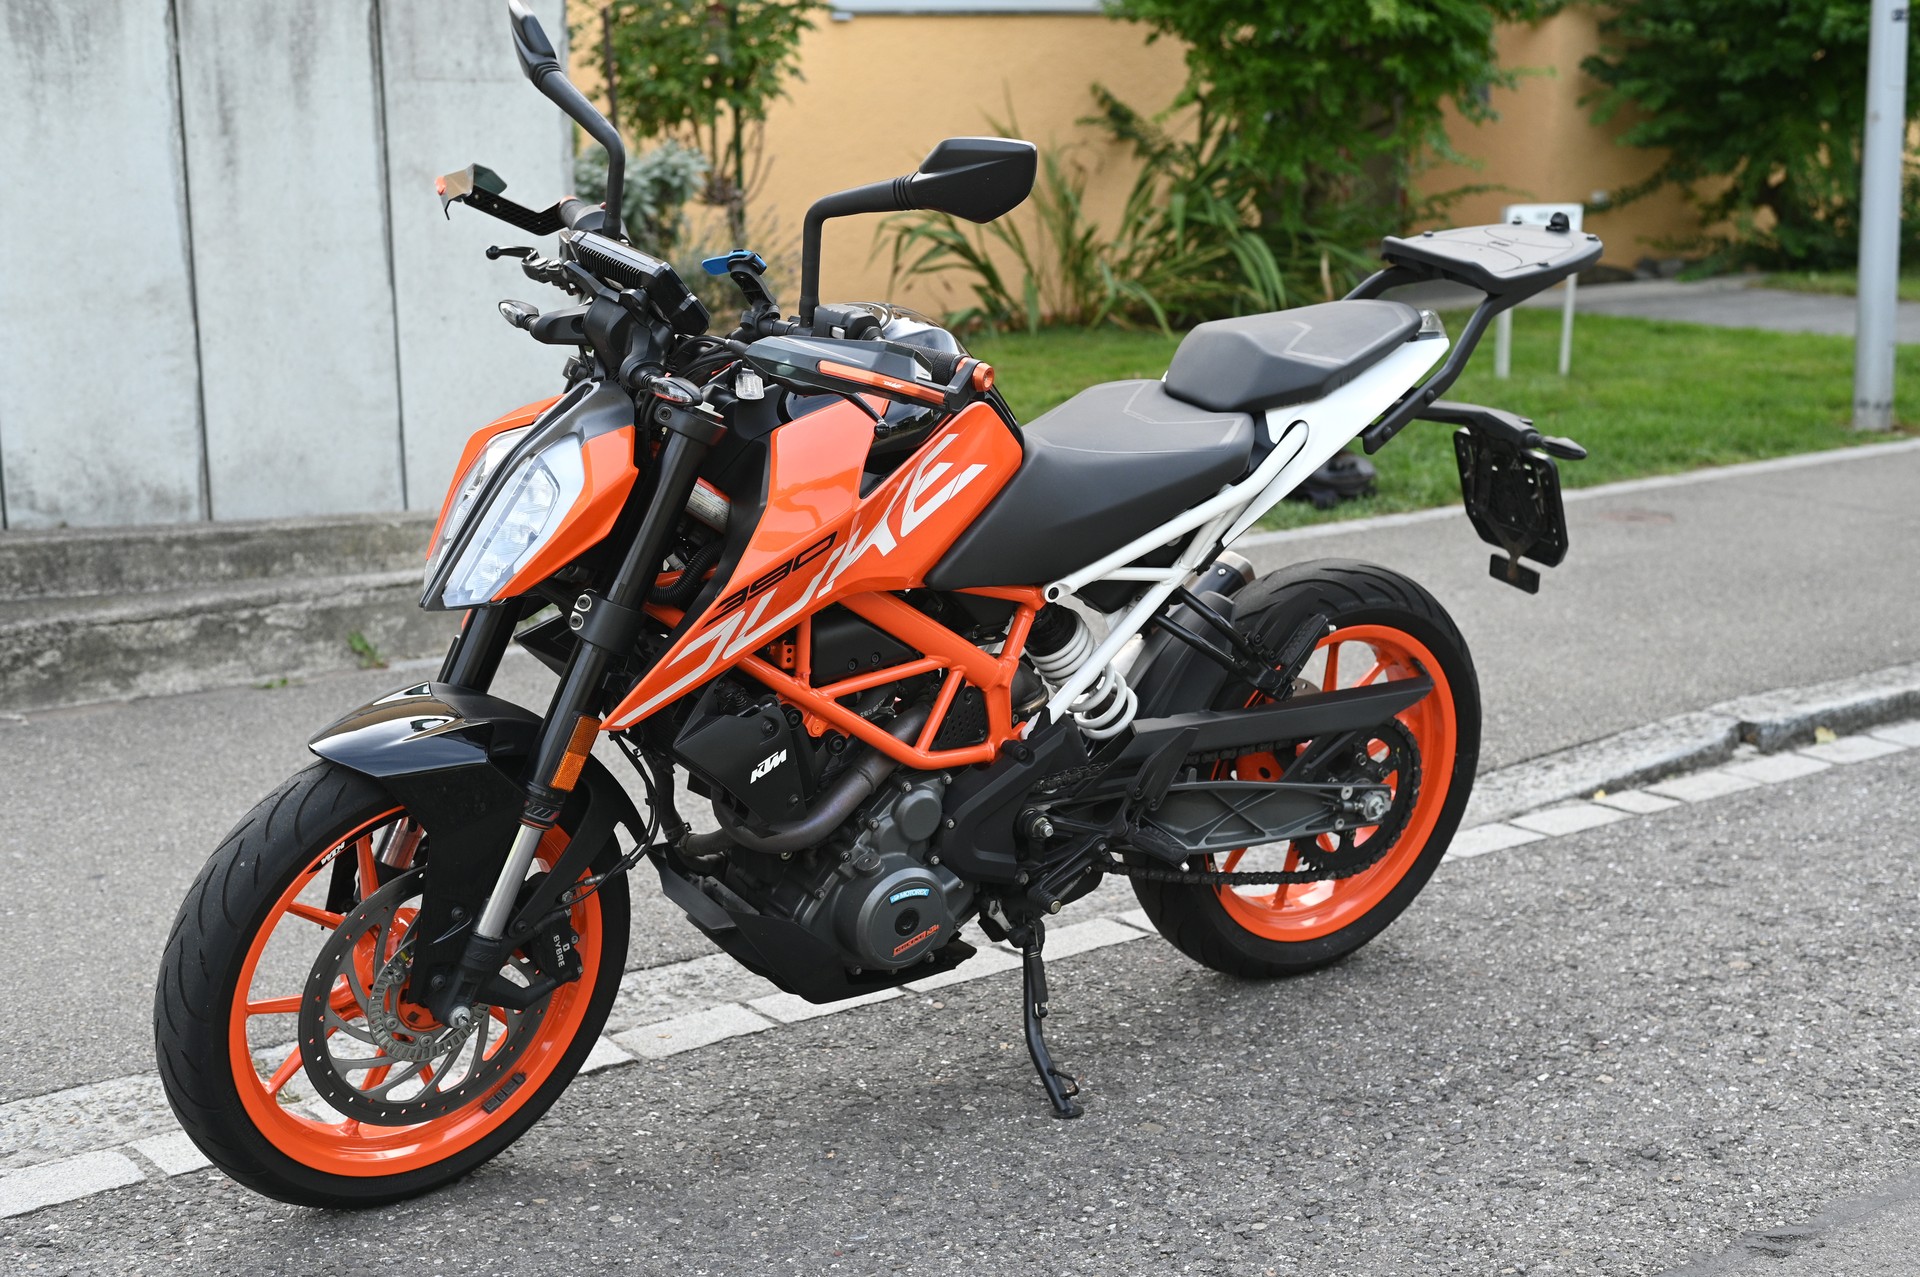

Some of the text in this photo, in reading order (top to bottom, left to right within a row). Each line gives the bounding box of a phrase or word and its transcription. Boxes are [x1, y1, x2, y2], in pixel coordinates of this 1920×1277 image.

[612, 433, 988, 727] DUKE
[700, 530, 838, 630] 390
[750, 749, 787, 784] KTM
[900, 888, 930, 898] MOTOREX
[553, 934, 565, 968] BYBRE
